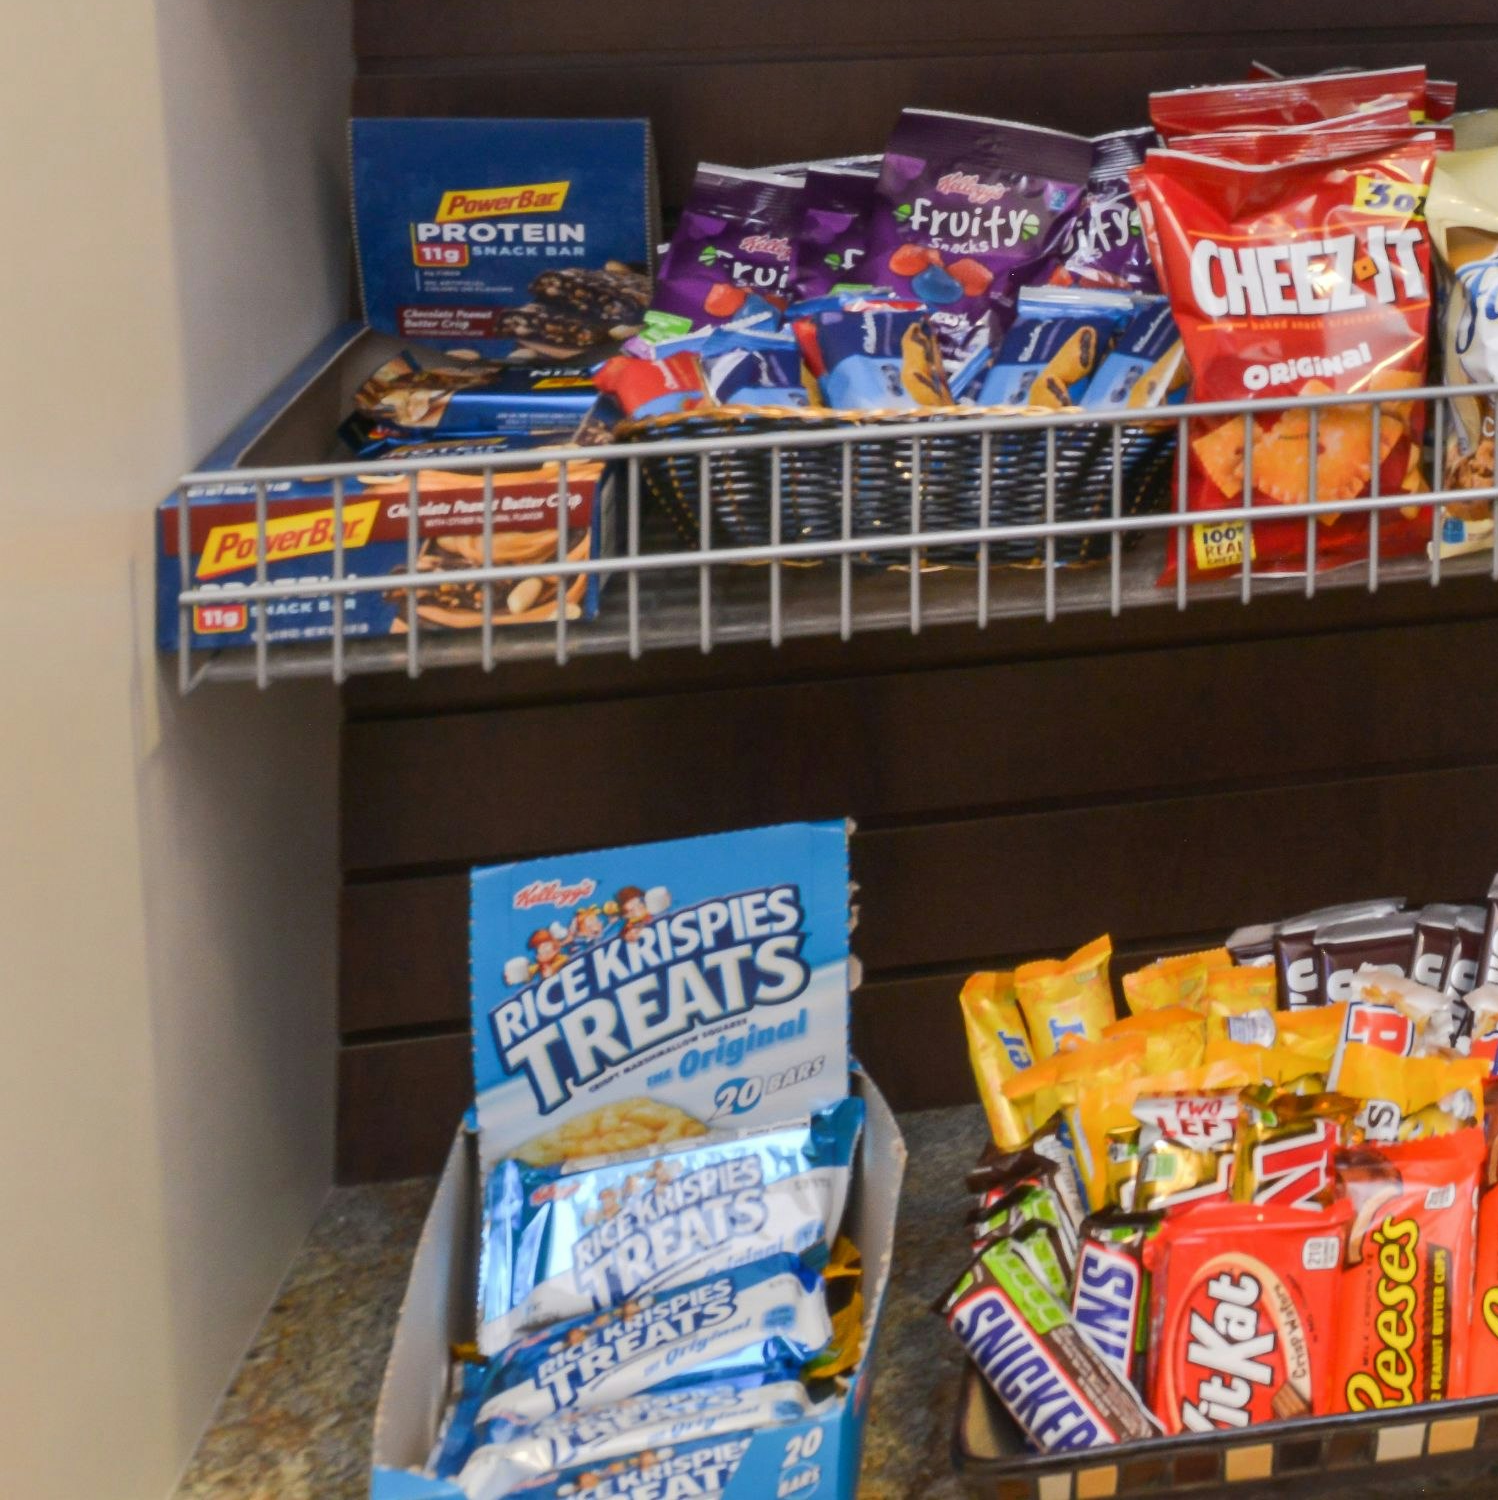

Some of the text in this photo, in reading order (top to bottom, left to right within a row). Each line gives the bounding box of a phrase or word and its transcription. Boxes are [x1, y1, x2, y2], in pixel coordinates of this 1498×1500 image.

[447, 190, 560, 216] PowerBar
[1364, 182, 1392, 209] 3
[417, 223, 585, 242] PROTEIN
[910, 198, 1029, 249] fruity
[928, 238, 990, 255] Snacks
[421, 246, 585, 263] 11g SNACK BAR
[501, 496, 546, 510] Butter
[214, 518, 364, 564] PowerBr
[203, 610, 239, 627] 11g
[514, 878, 596, 908] Kellogg's
[494, 888, 799, 1047] RICE KRISPIES
[505, 935, 808, 1112] TREATS
[678, 1008, 808, 1079] Original
[713, 1055, 826, 1115] 20 BARS
[1176, 1100, 1223, 1116] TWO
[574, 1155, 763, 1262] RICE KRISPIES
[578, 1189, 767, 1306] TREATS
[537, 1278, 734, 1379] RICE KRISPIES
[1347, 1214, 1419, 1412] Reese's
[542, 1299, 736, 1411] TREATS
[954, 1298, 1098, 1450] SNICKER
[781, 1426, 824, 1470] 20
